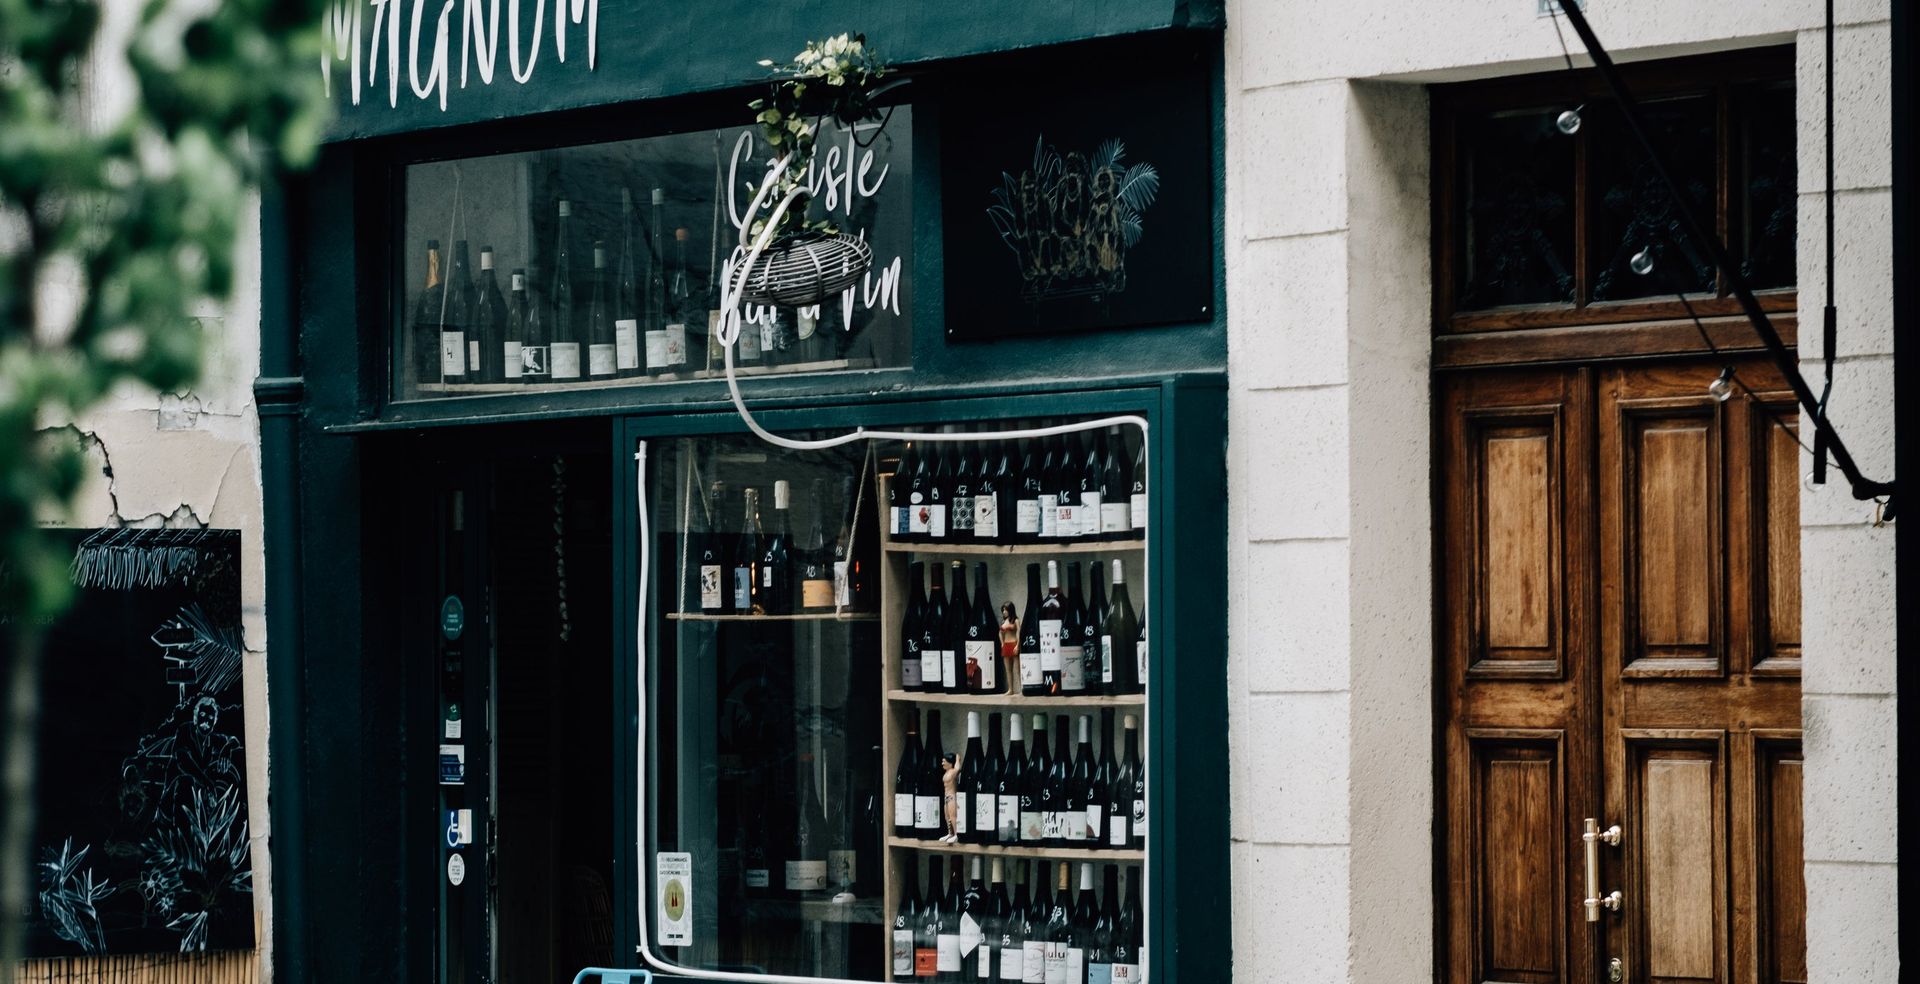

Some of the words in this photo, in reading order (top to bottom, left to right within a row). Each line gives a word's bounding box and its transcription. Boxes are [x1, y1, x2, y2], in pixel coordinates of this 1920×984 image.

[321, 0, 598, 111] MAGNUM
[728, 121, 889, 230] Caiste
[1132, 481, 1144, 492] 13
[1058, 490, 1070, 504] 16
[805, 566, 816, 578] 18
[967, 626, 978, 638] 18
[1084, 625, 1094, 637] 18
[1022, 635, 1036, 646] 13
[895, 915, 905, 928] 18
[1115, 945, 1127, 958] 13
